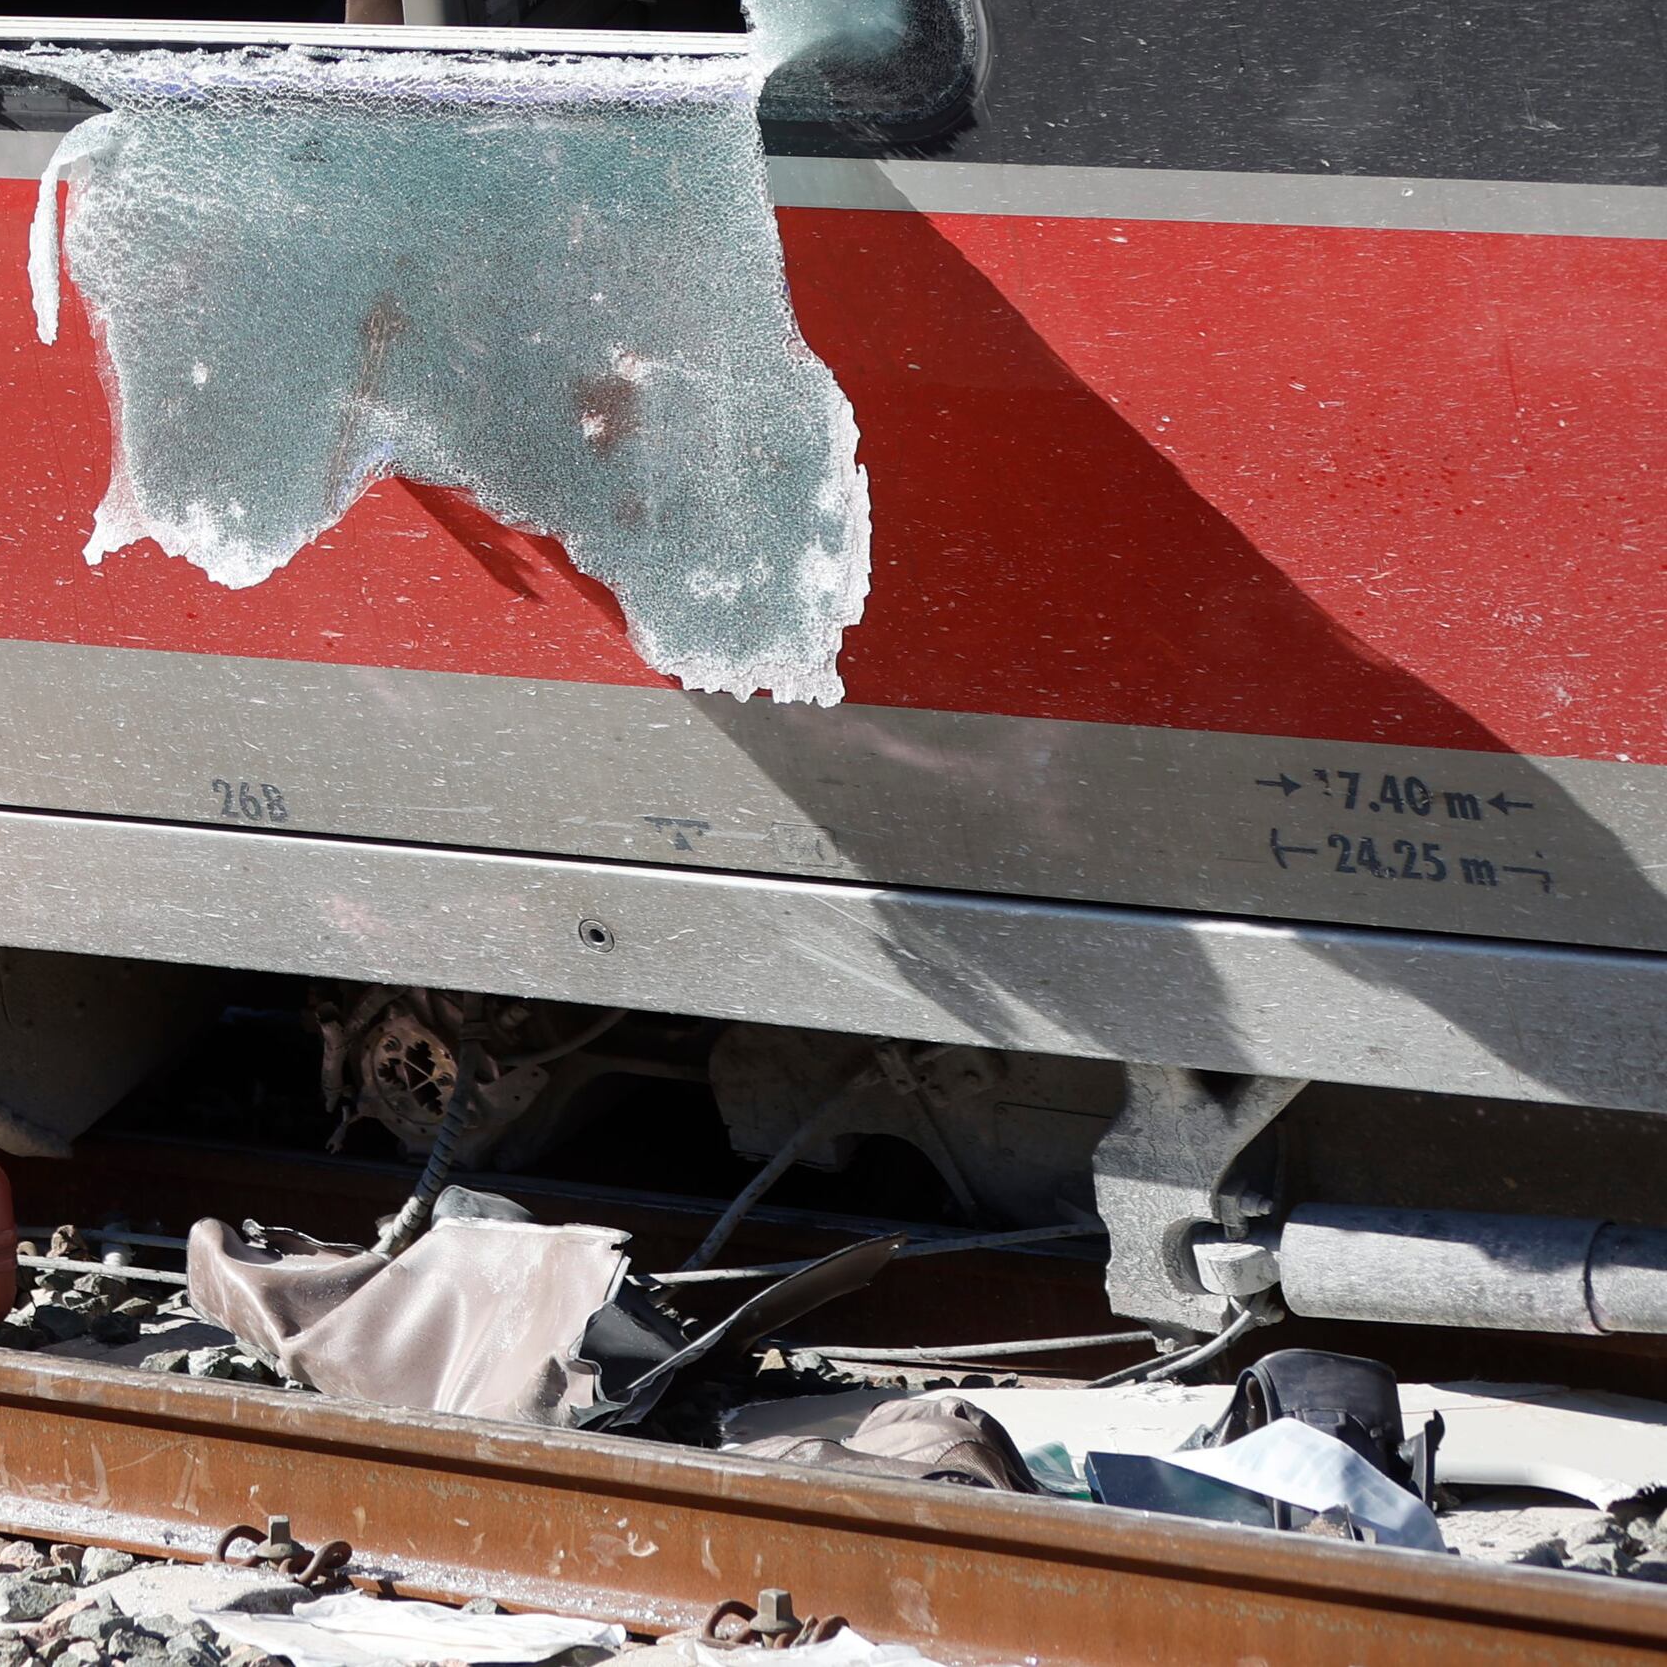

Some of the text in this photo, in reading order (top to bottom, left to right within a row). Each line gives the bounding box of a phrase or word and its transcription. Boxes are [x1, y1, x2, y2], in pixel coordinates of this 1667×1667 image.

[212, 779, 288, 822] 268
[1444, 792, 1482, 821] m
[1327, 834, 1498, 887] 24.25 m
